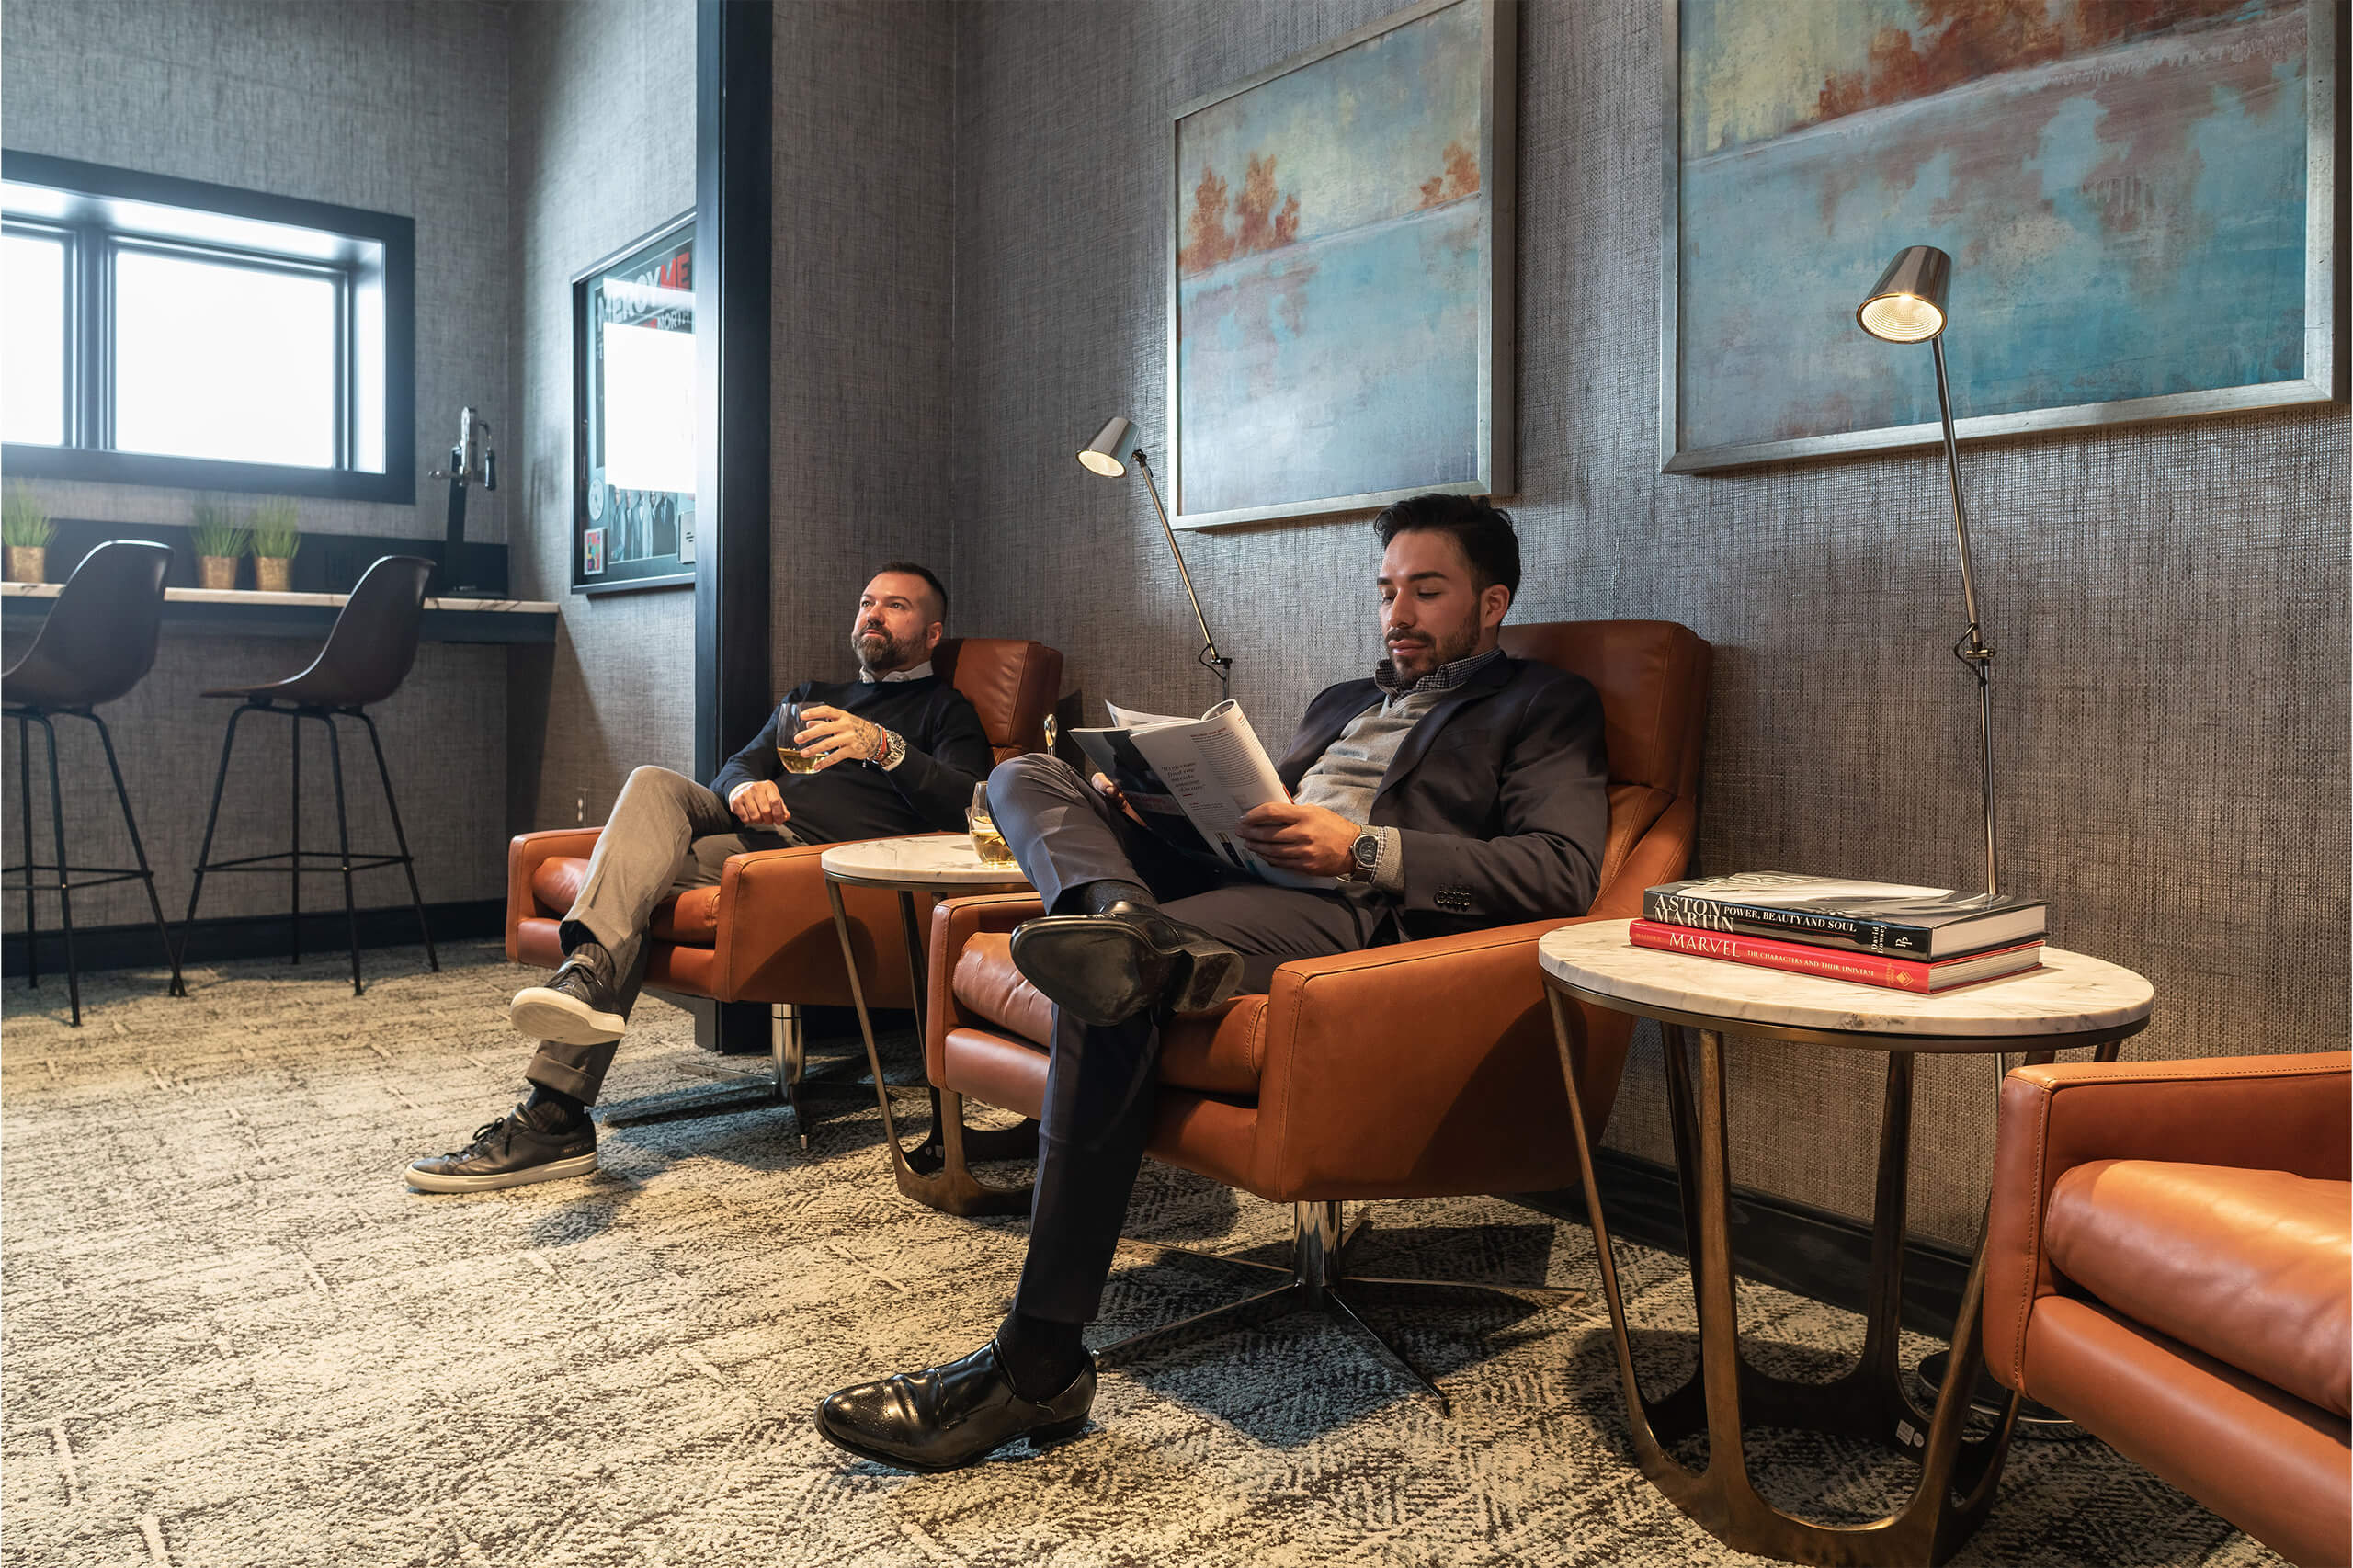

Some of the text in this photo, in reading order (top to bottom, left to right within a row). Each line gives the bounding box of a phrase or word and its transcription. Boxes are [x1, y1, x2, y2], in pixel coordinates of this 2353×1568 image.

[1654, 894, 1721, 916] ASTON
[1654, 908, 1733, 932] MARTIN
[1724, 906, 1857, 932] POWER, BEAUTY AND SOUL
[1669, 932, 1740, 957] MARVEL
